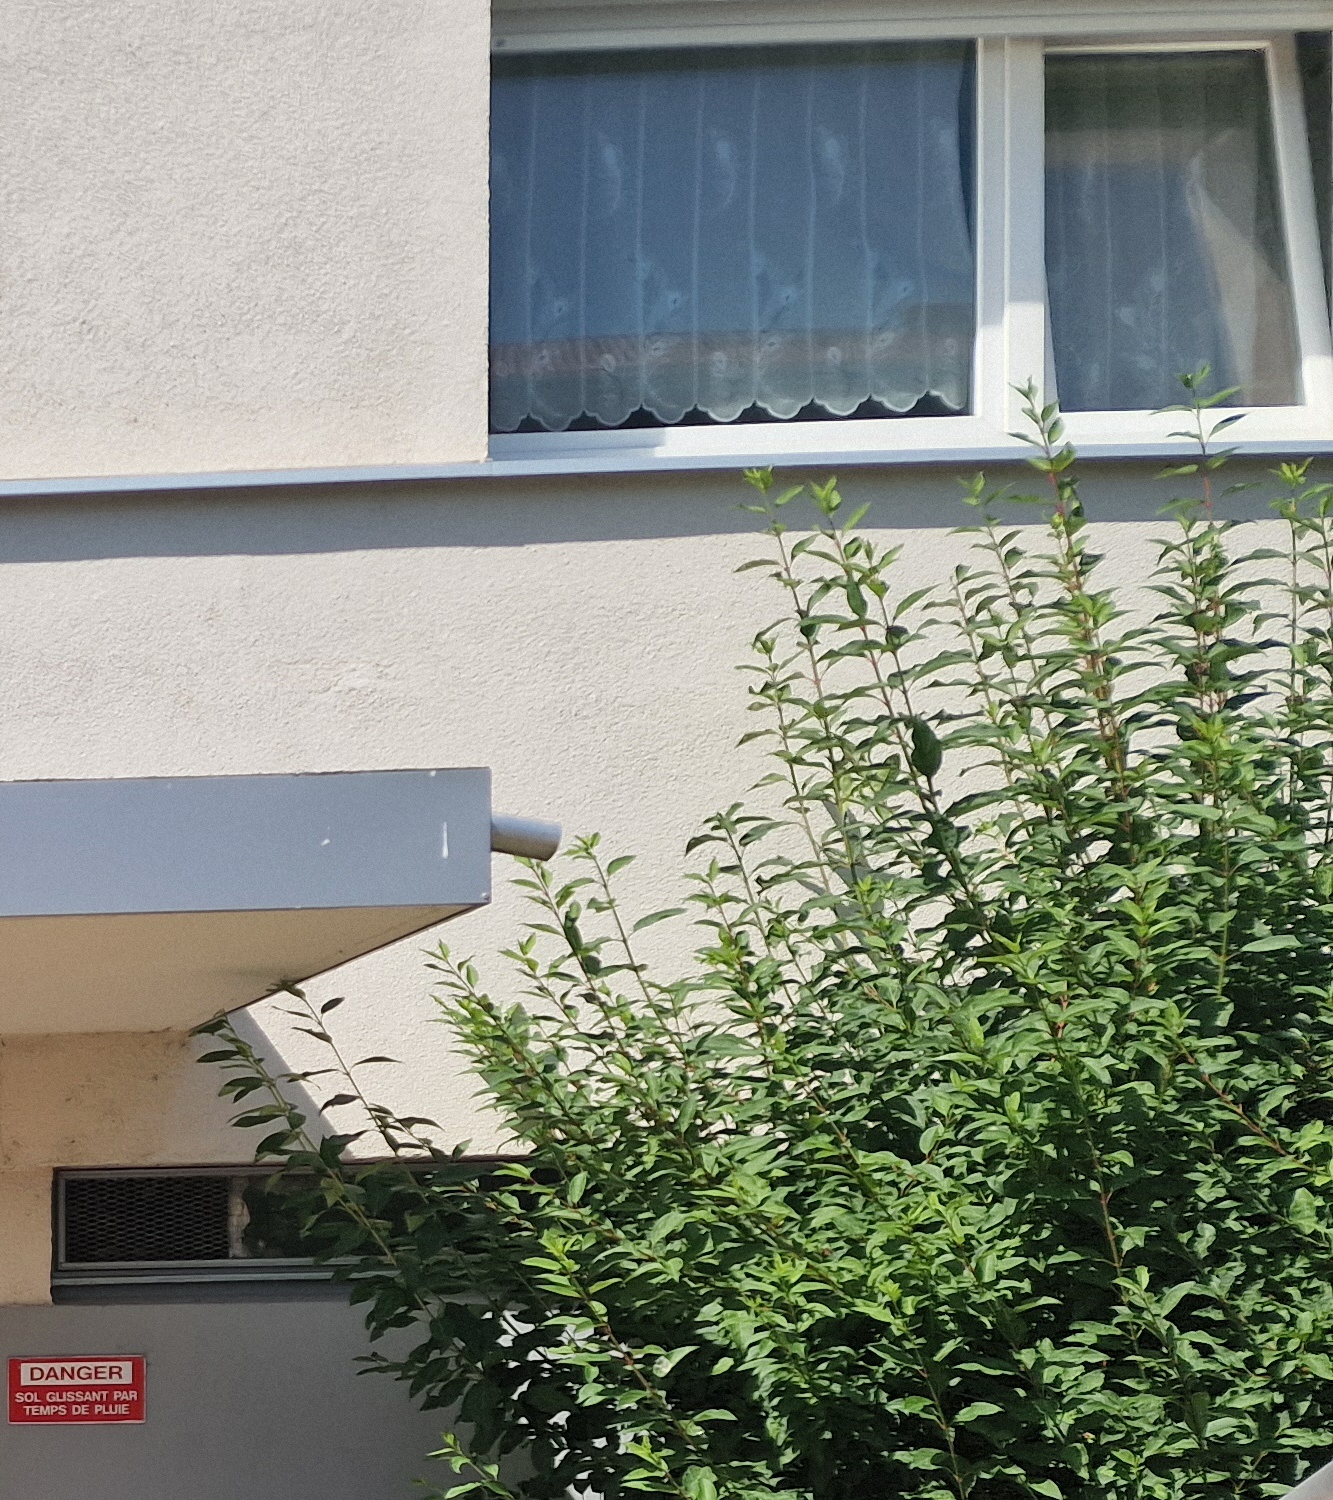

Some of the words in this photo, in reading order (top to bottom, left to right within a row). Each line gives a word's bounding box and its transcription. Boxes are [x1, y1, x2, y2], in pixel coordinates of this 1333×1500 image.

[29, 1365, 123, 1381] DANGER
[14, 1391, 41, 1403] SOL
[46, 1391, 109, 1403] GLISSANT
[113, 1390, 138, 1401] PAR
[23, 1405, 67, 1416] TEMPS
[72, 1405, 90, 1415] DE
[94, 1404, 130, 1415] PLUIE
